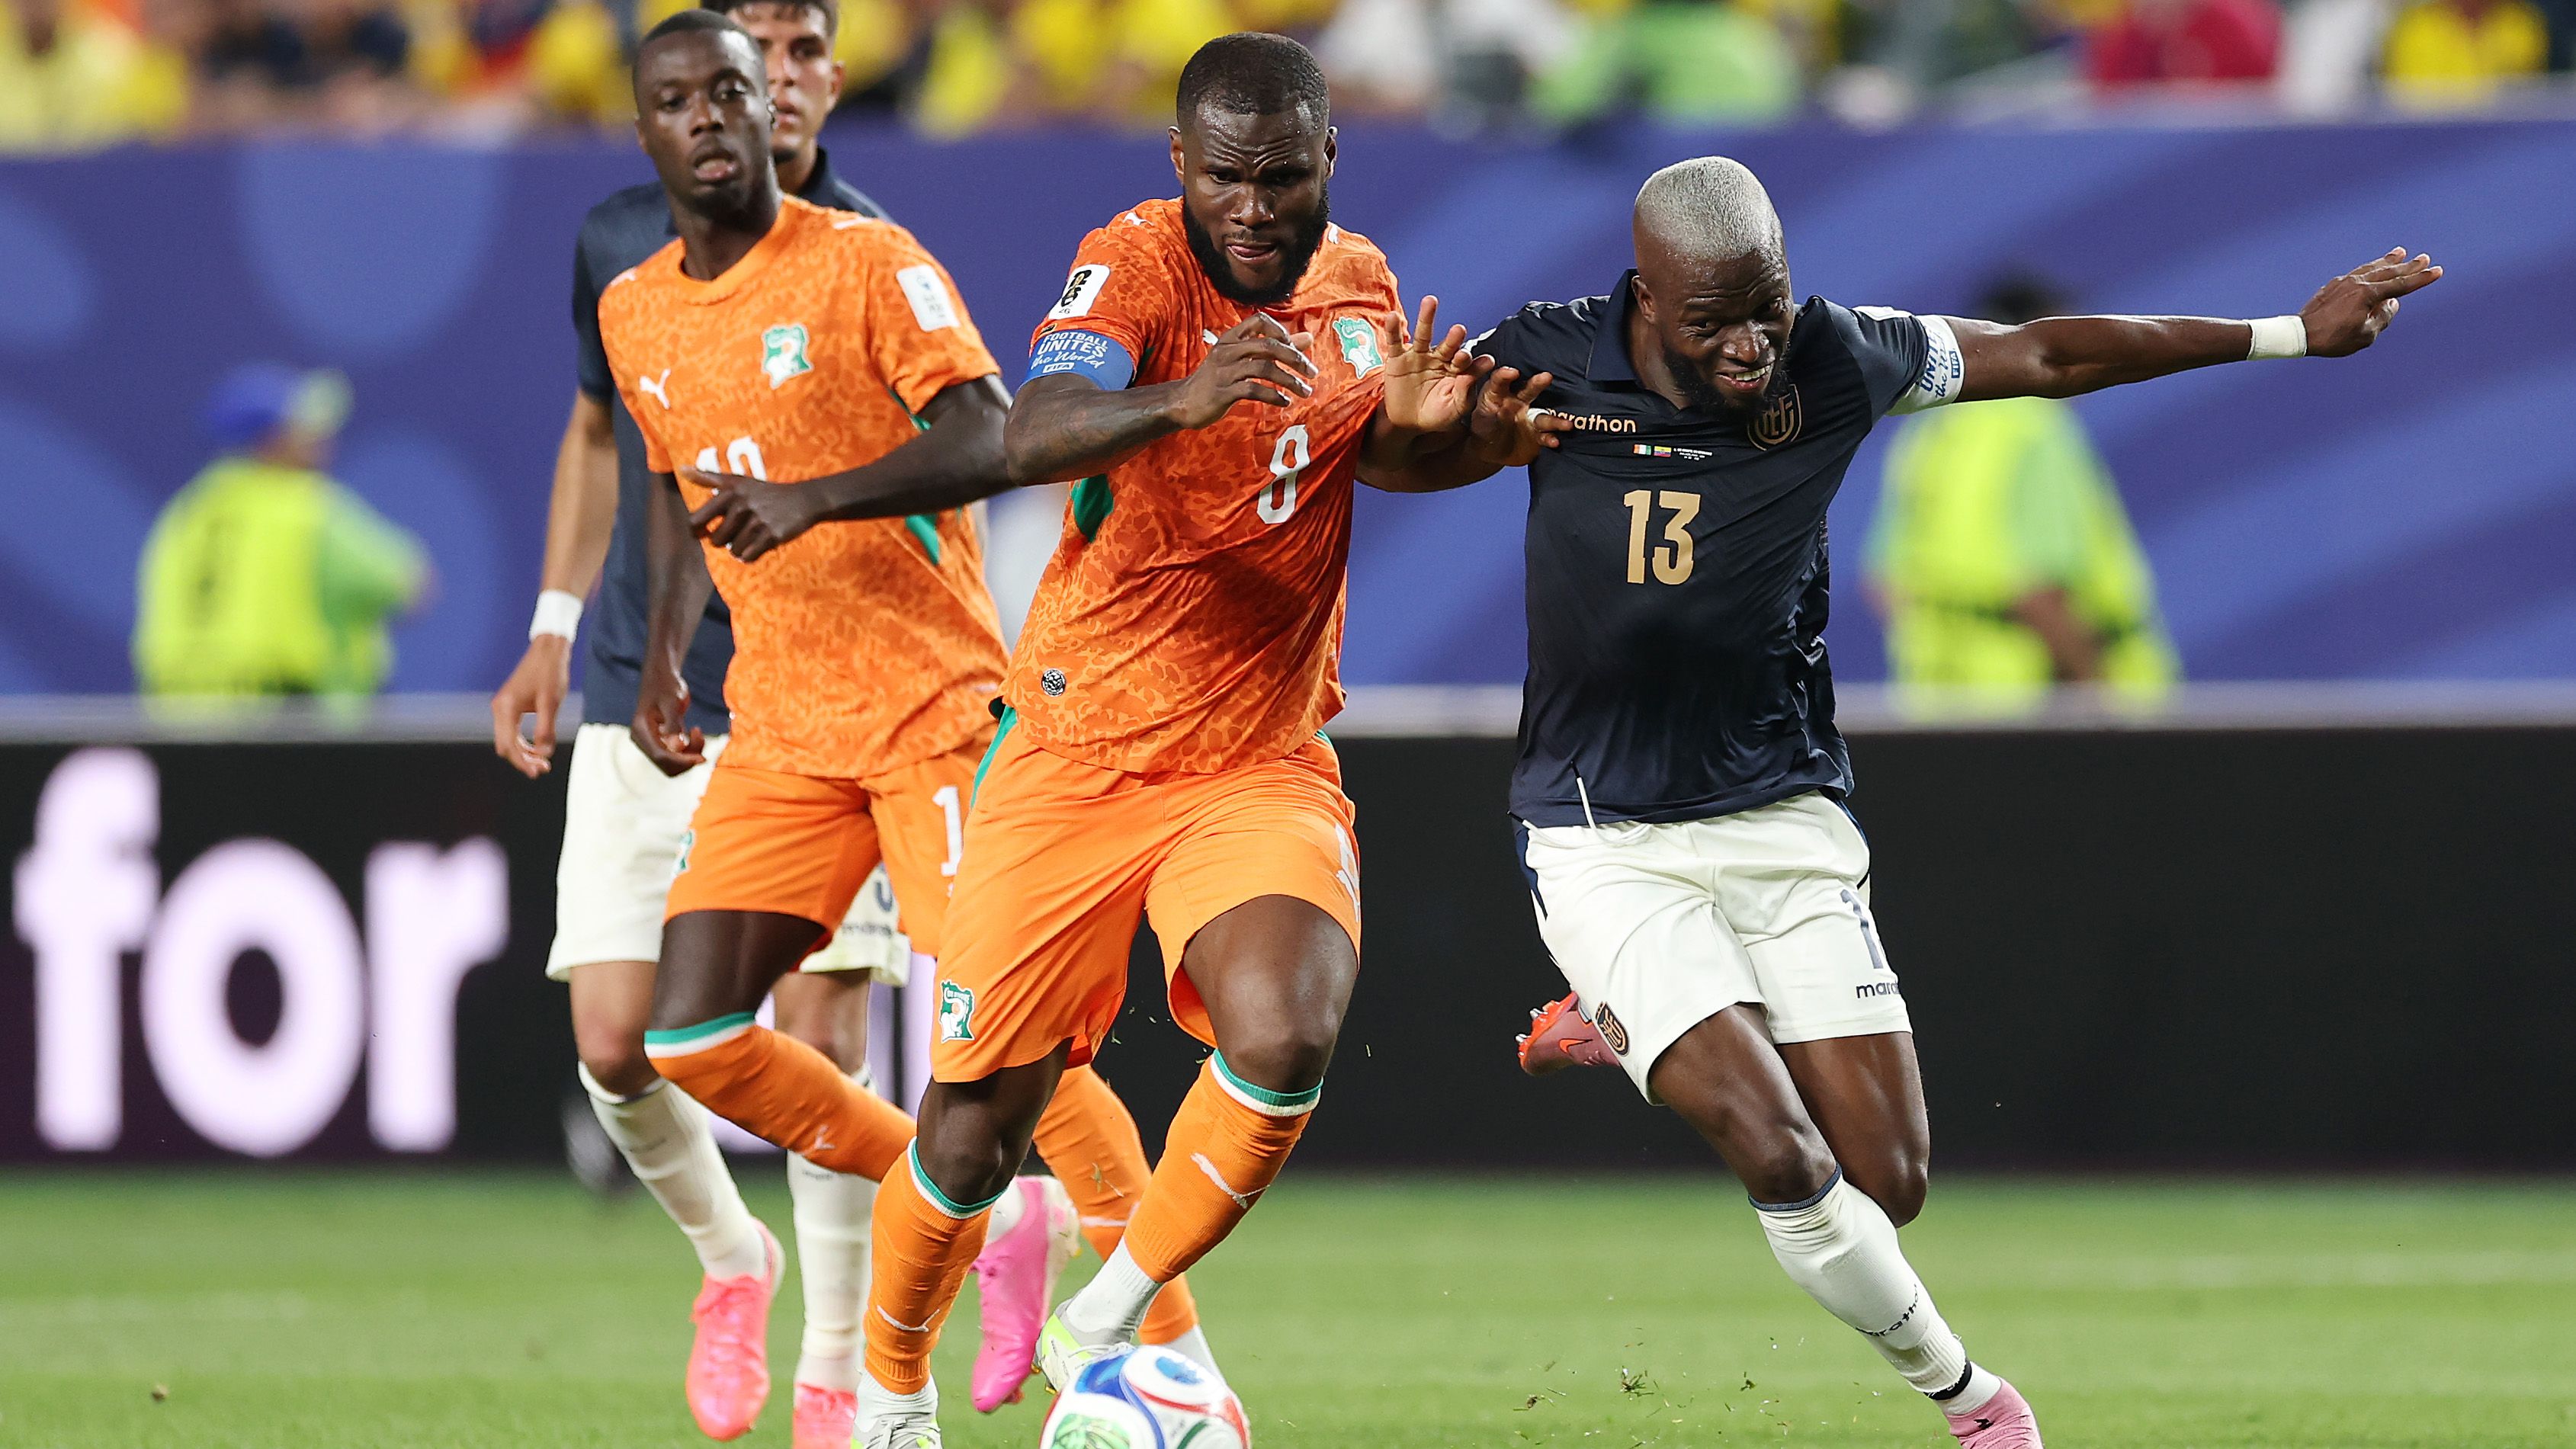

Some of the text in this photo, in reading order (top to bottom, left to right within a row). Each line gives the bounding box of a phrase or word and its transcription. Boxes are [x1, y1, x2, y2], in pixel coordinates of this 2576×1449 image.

[1038, 340, 1107, 357] UNITES
[1043, 332, 1108, 349] FOOTBALL
[1031, 351, 1105, 370] the World
[1919, 331, 1939, 392] UNIT
[1950, 352, 1959, 377] FIFA
[1935, 373, 1948, 398] the
[1256, 424, 1310, 524] 8
[1623, 489, 1701, 585] 13
[12, 745, 510, 1157] for
